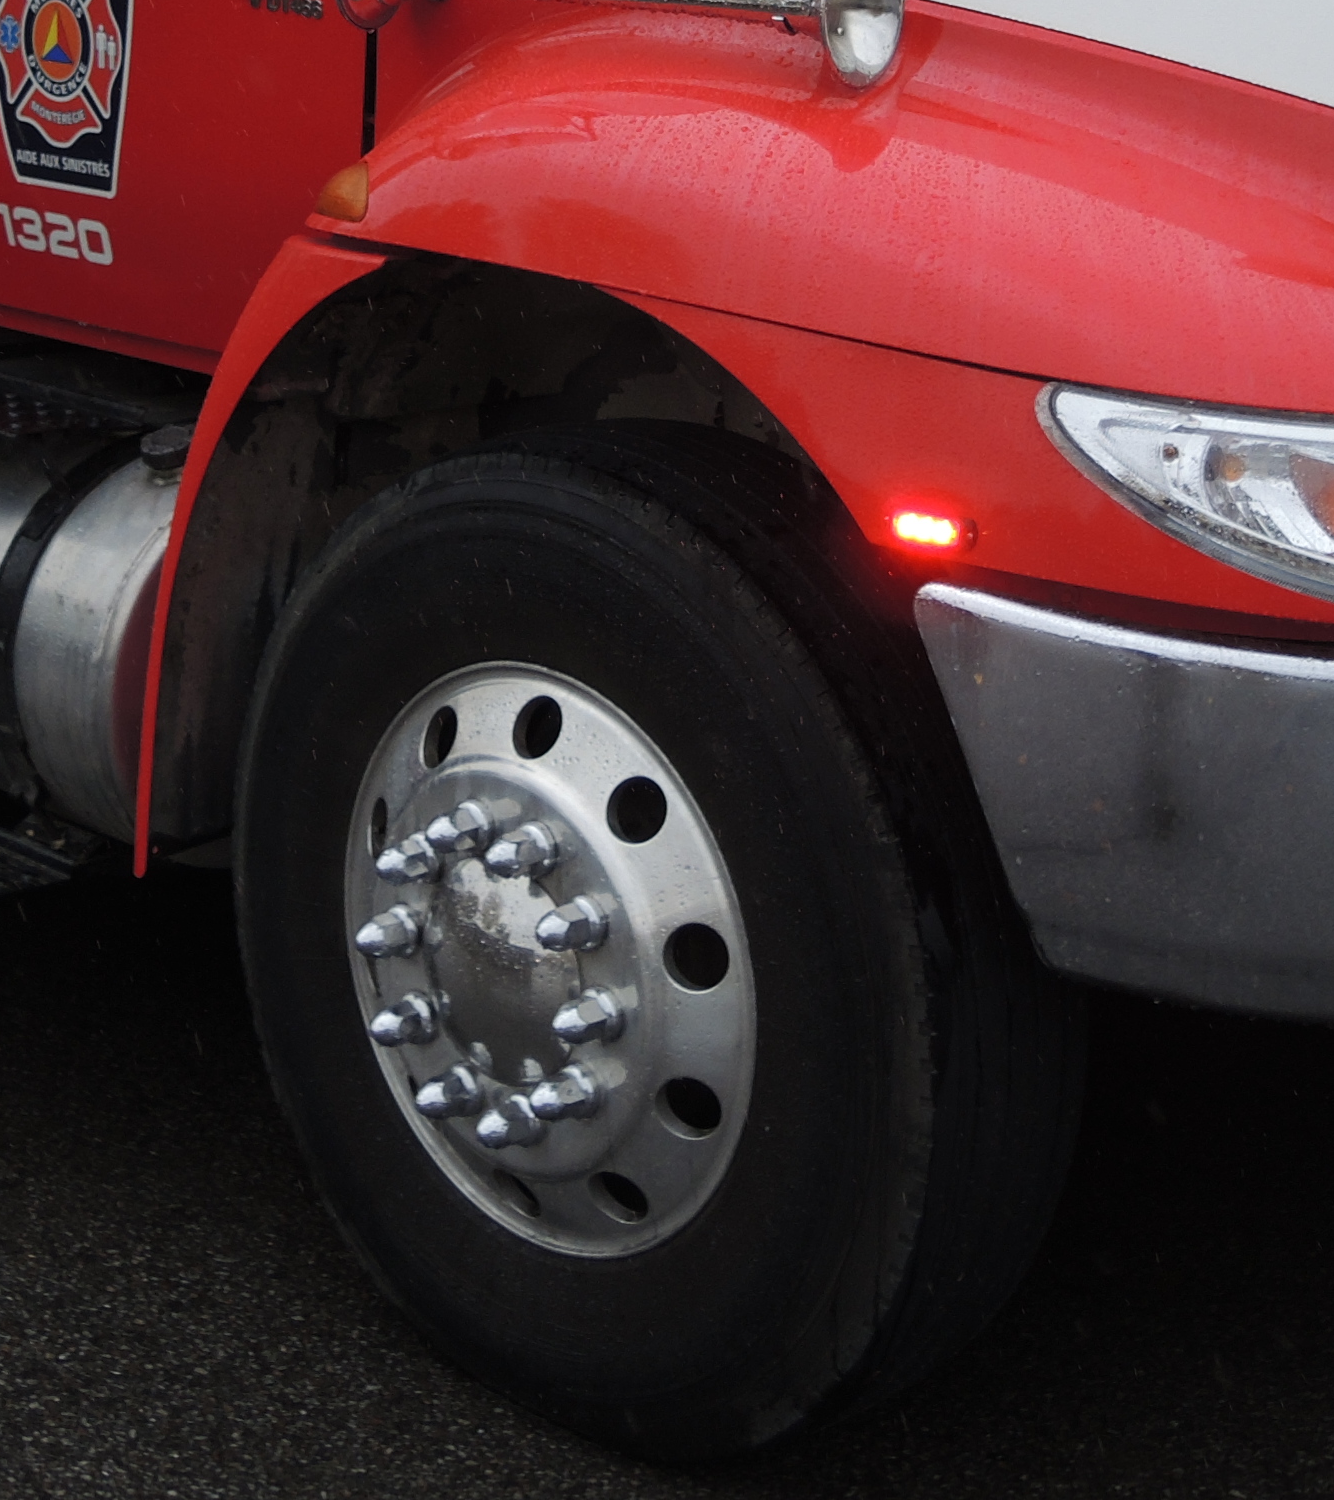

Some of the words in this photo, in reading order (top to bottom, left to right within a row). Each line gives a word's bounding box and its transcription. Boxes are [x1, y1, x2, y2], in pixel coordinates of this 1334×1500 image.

[27, 54, 88, 96] D'URGENCE
[16, 149, 38, 166] AIDE
[39, 153, 61, 170] AUX
[62, 156, 110, 178] SINISTRÉS
